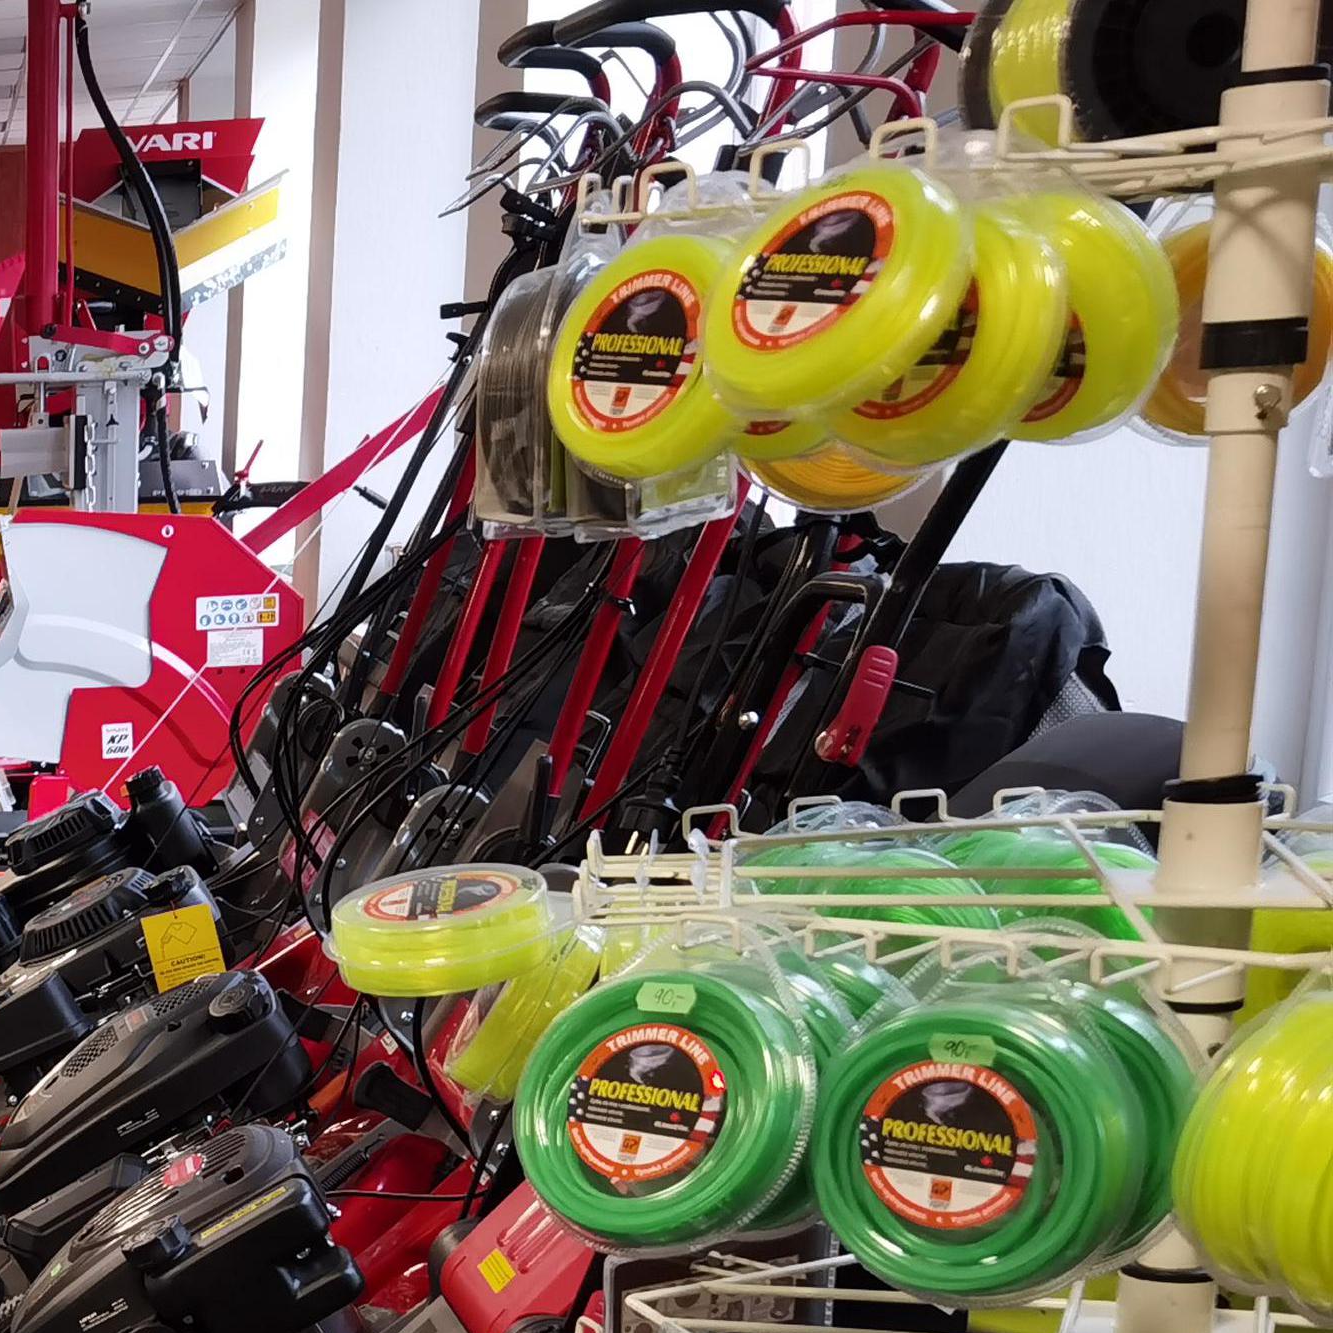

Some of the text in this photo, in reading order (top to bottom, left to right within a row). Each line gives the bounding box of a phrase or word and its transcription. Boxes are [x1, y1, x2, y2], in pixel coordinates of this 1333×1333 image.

[128, 131, 213, 152] VARI
[763, 253, 870, 277] PROFESSIONAL
[610, 273, 673, 305] TRIMMER
[591, 332, 684, 356] PROFESSIONAL
[171, 953, 206, 967] CAUTION!
[605, 1027, 710, 1066] TRIMMER LINE
[588, 1077, 701, 1113] PROFESSIONAL
[892, 1063, 1018, 1106] TRIMMER LINE
[882, 1117, 1013, 1157] PROFESSIONAL
